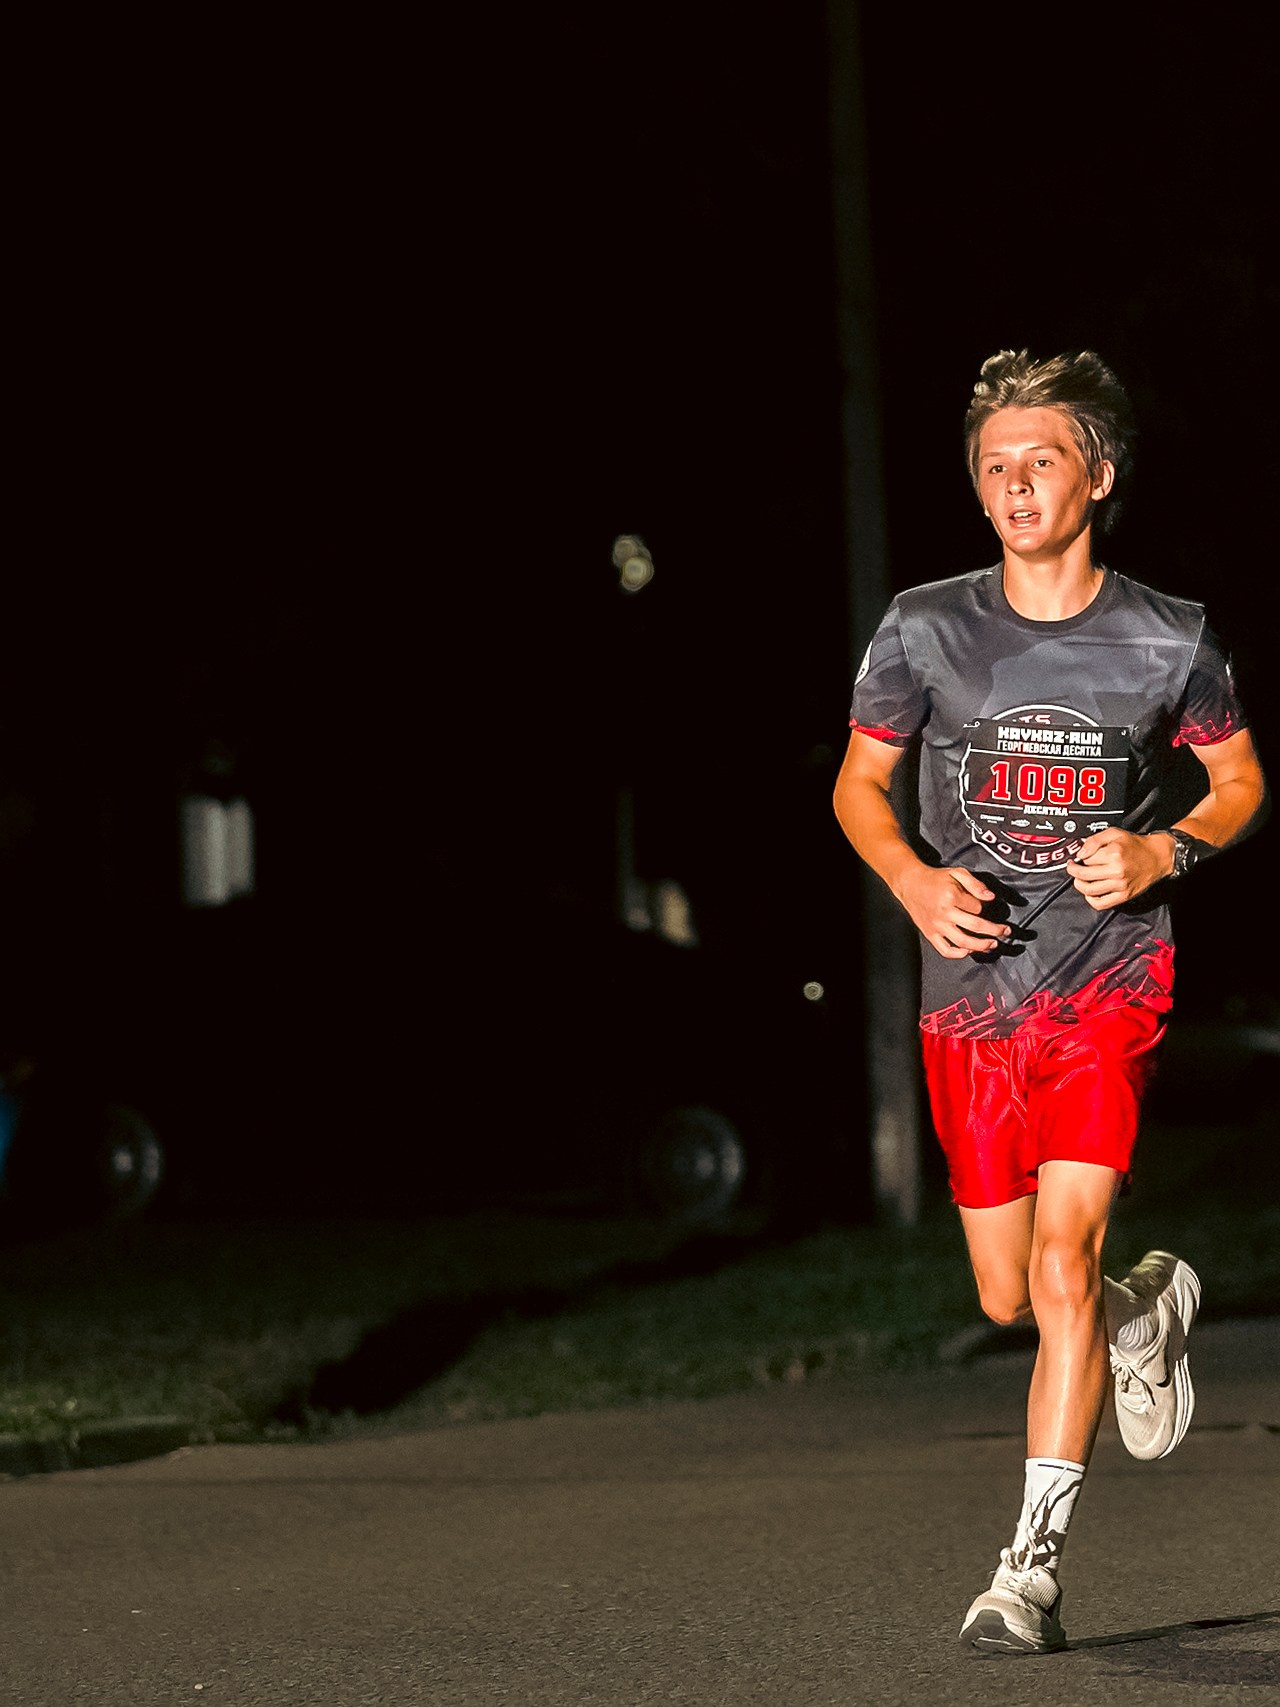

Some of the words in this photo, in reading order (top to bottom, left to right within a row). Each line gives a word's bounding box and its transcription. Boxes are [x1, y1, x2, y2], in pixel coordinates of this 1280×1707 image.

[997, 739, 1062, 755] ГЕОРГИЕВСКАЯ
[1062, 744, 1102, 757] ДЕСЯТКА
[991, 761, 1106, 806] 1098
[1023, 805, 1069, 817] ДЕСЯТКА
[1020, 837, 1085, 865] LEGE
